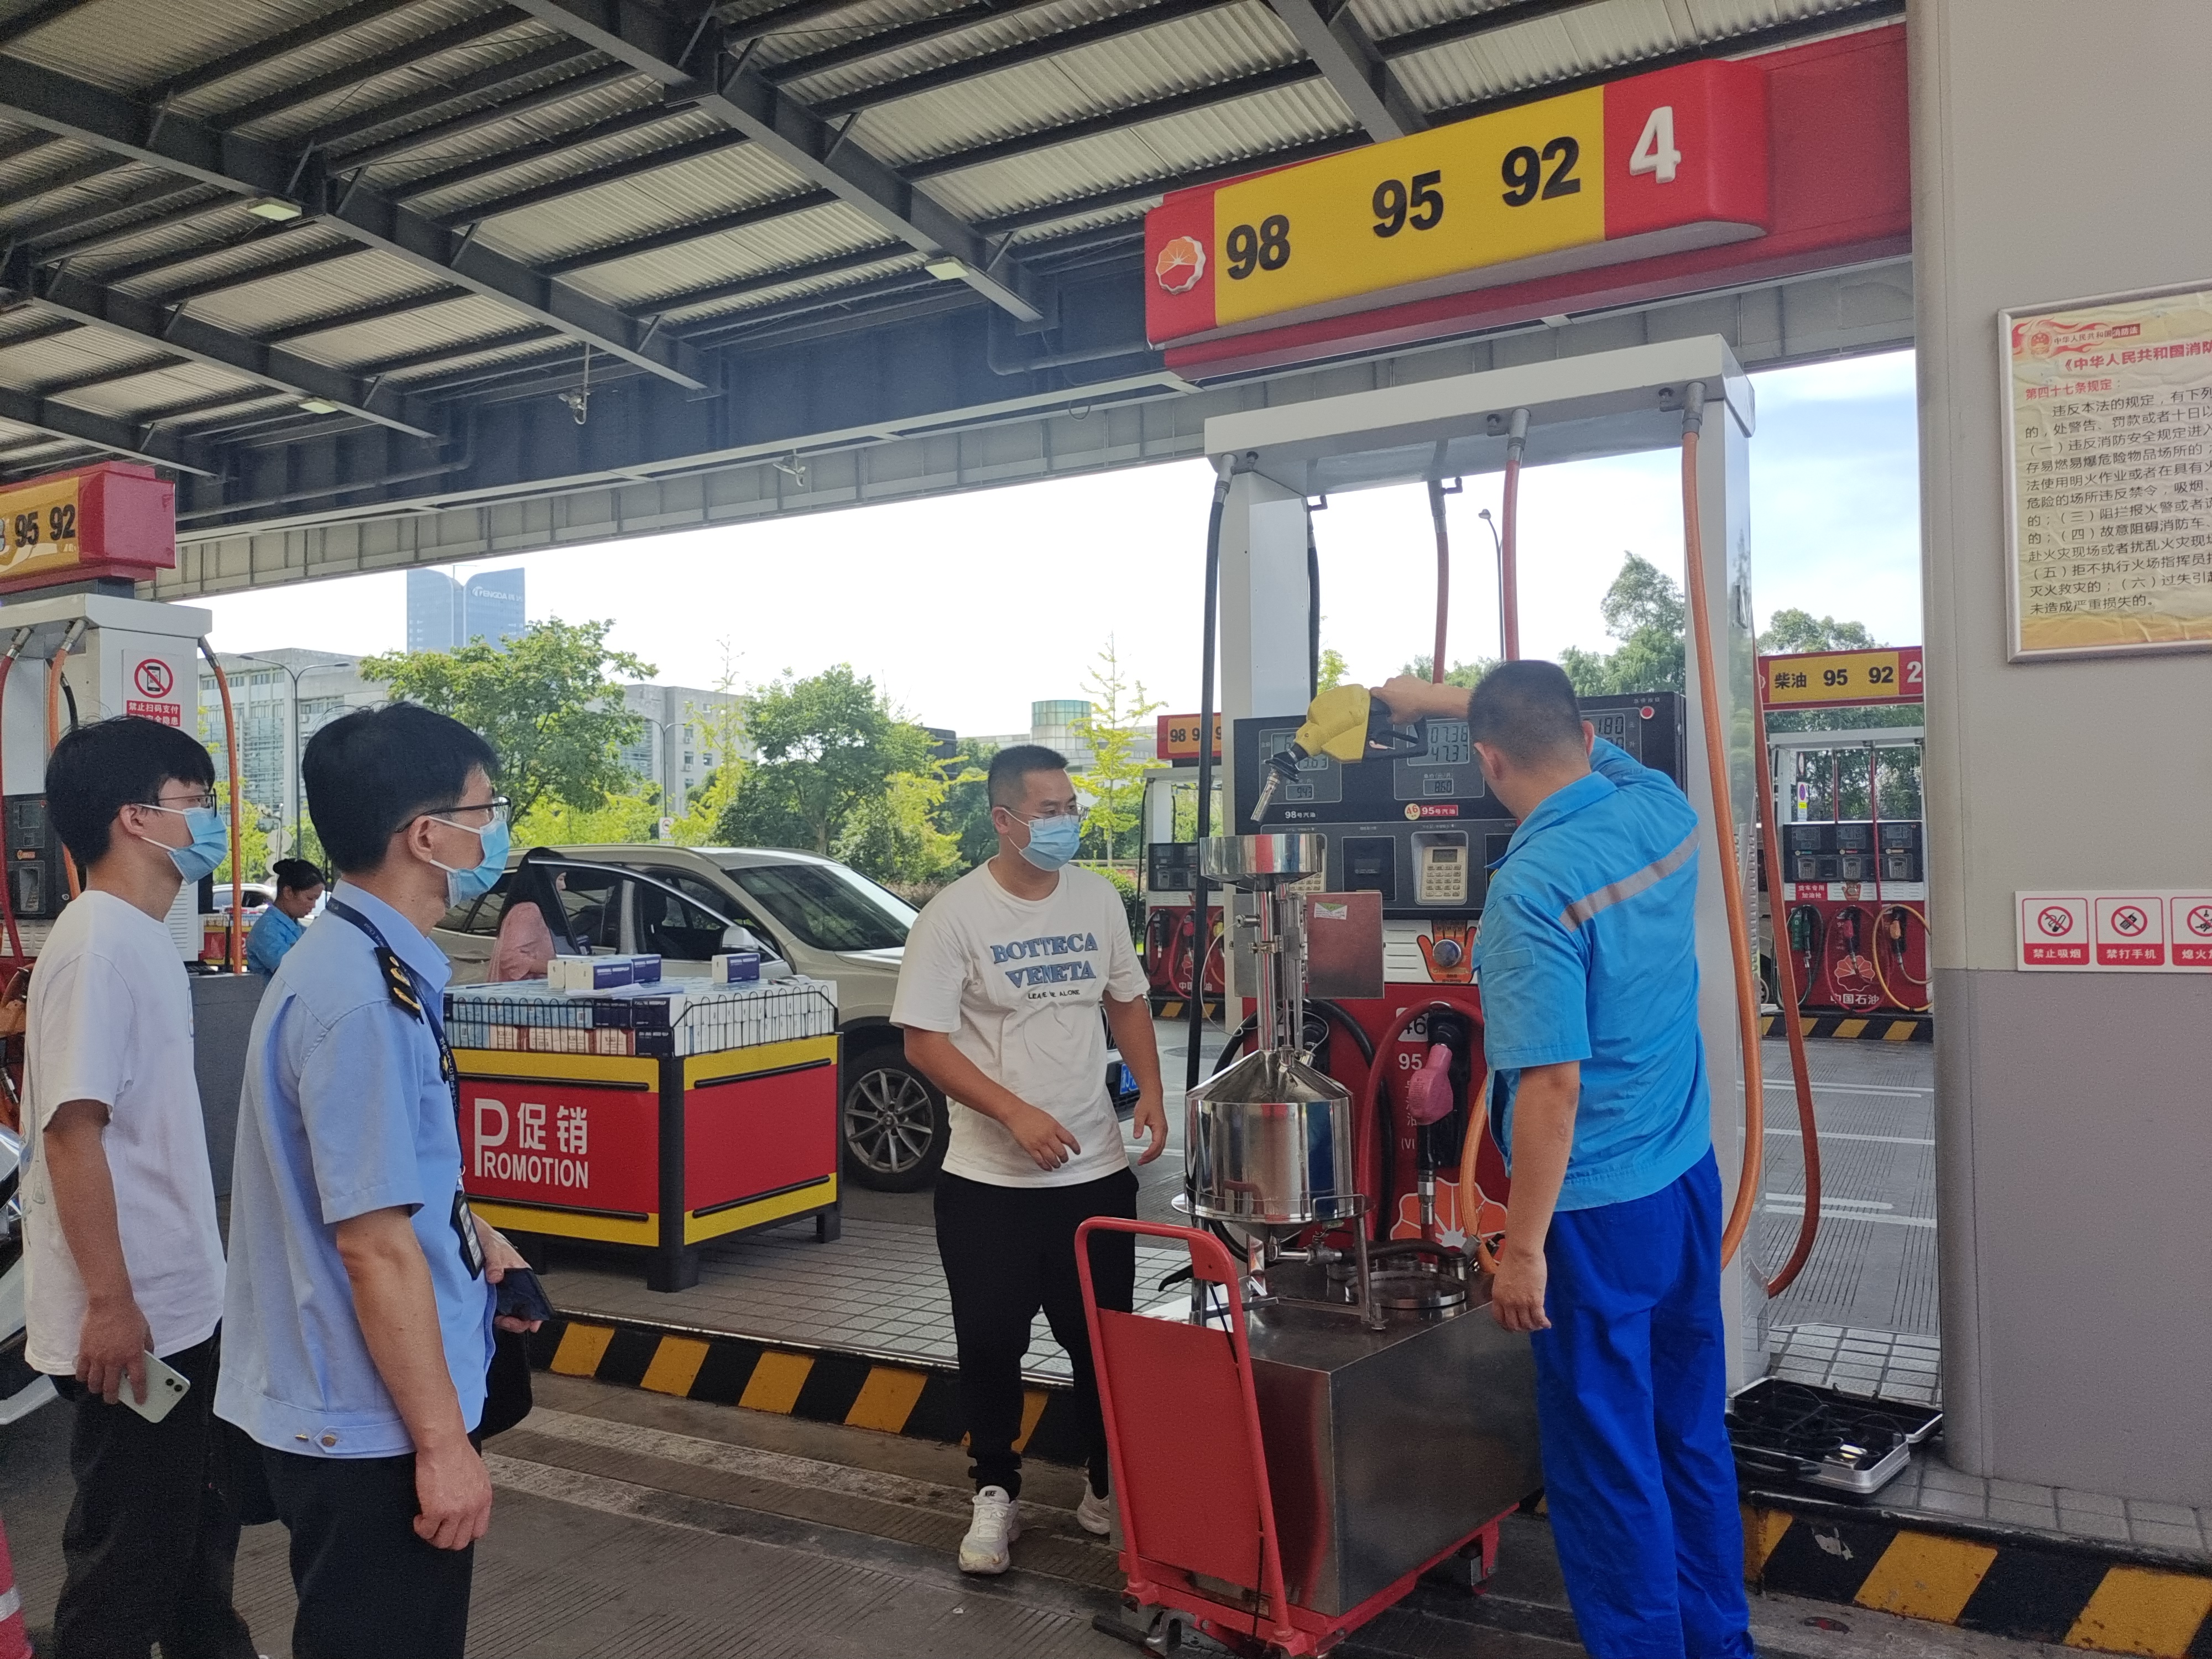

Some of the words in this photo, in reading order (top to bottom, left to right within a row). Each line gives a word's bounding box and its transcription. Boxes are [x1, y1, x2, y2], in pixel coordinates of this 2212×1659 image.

[1226, 215, 1291, 280] 98
[1371, 170, 1444, 238] 95
[1501, 136, 1581, 207] 92
[1629, 105, 1681, 184] 4
[15, 511, 39, 547] 95
[49, 504, 76, 541] 92
[1774, 672, 1807, 690] 柴油
[1823, 669, 1848, 686] 95
[1868, 666, 1893, 684] 92
[1907, 661, 1922, 683] 2
[129, 702, 179, 714] 禁止扫码支付
[1170, 729, 1186, 742] 98
[1192, 727, 1200, 742] 9
[1406, 805, 1418, 815] 46
[2033, 948, 2081, 959] 禁止吸烟
[1005, 960, 1097, 988] VENETA
[1830, 993, 1880, 1005] 中国石油
[1399, 1053, 1422, 1070] 95
[518, 1102, 588, 1155] 促销
[474, 1098, 589, 1189] PROMOTION
